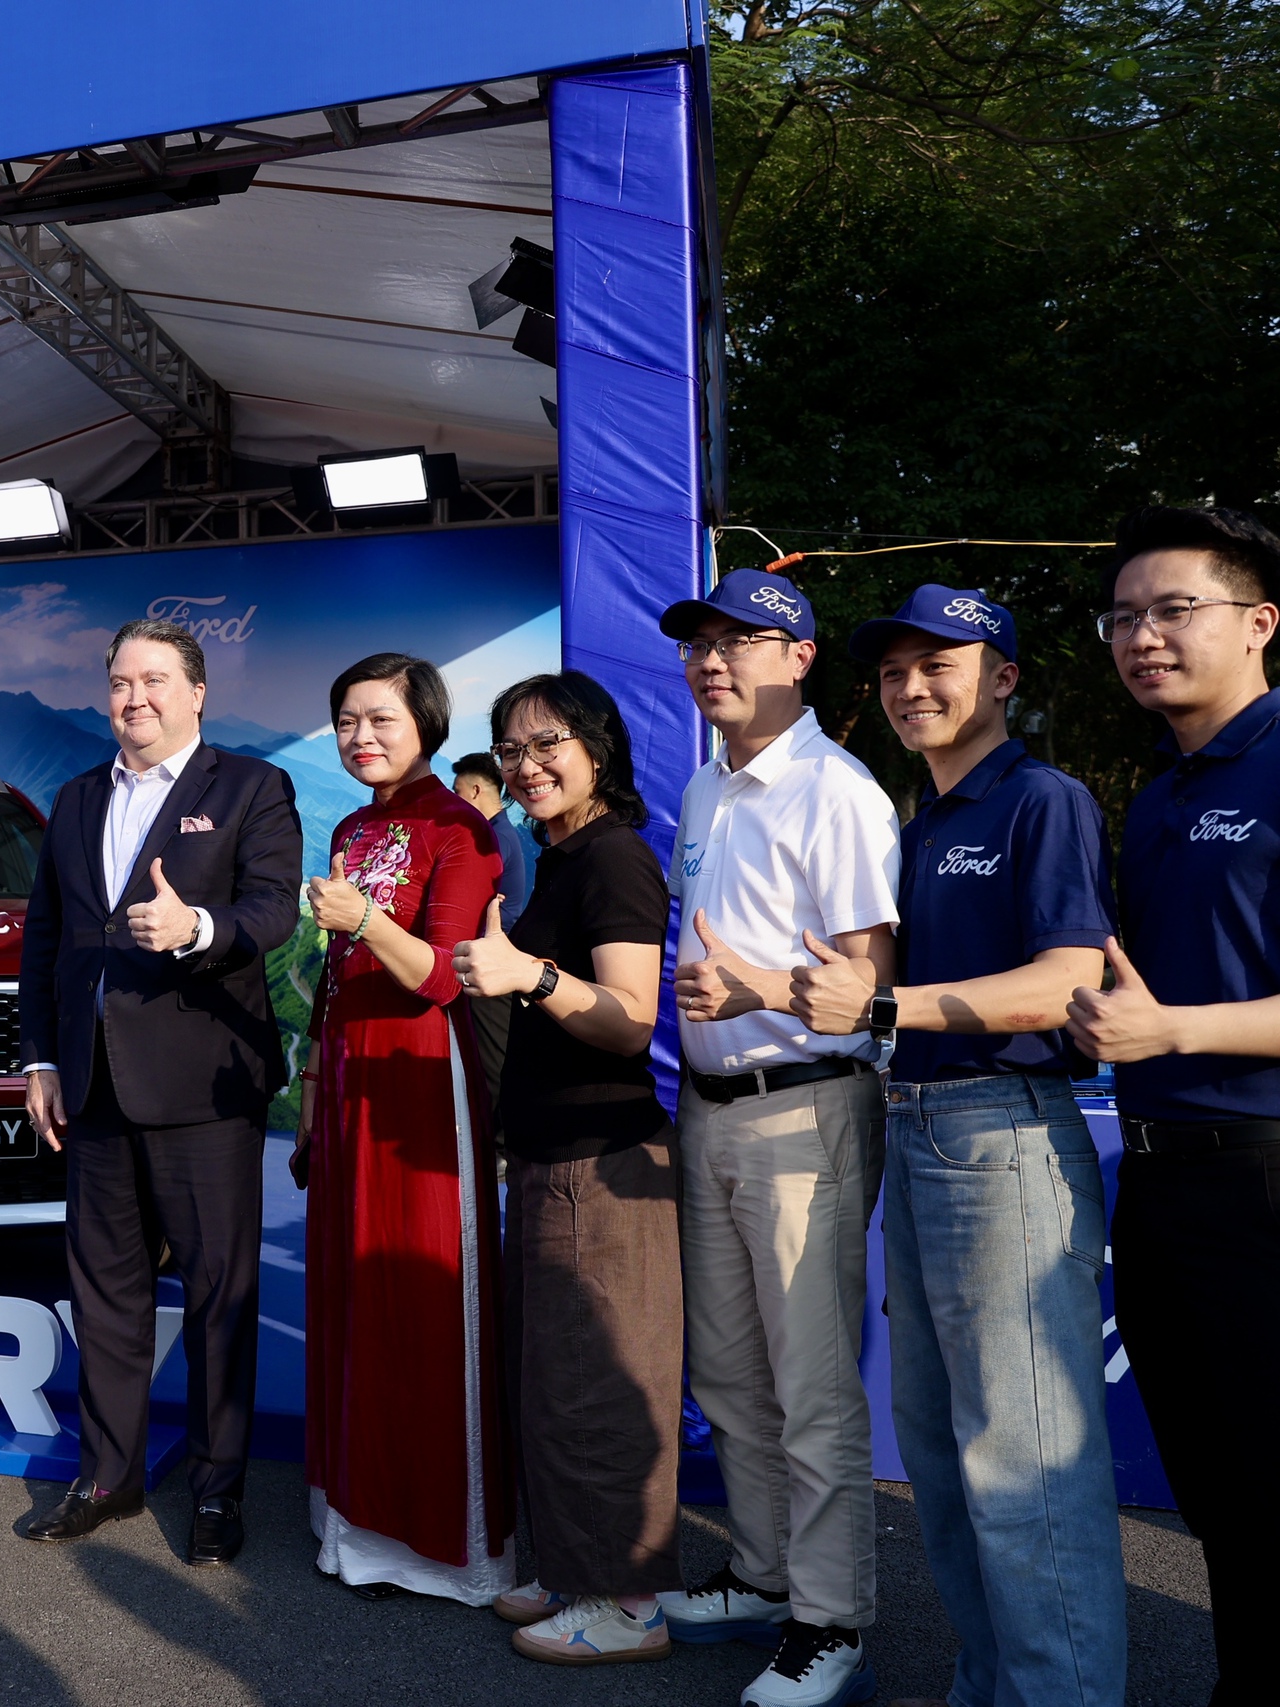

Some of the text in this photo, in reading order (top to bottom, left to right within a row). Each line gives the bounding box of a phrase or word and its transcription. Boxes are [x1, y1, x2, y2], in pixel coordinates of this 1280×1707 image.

[750, 586, 802, 624] Ford
[943, 597, 1002, 635] Ford
[1189, 809, 1257, 842] Ford
[937, 845, 1002, 876] Ford
